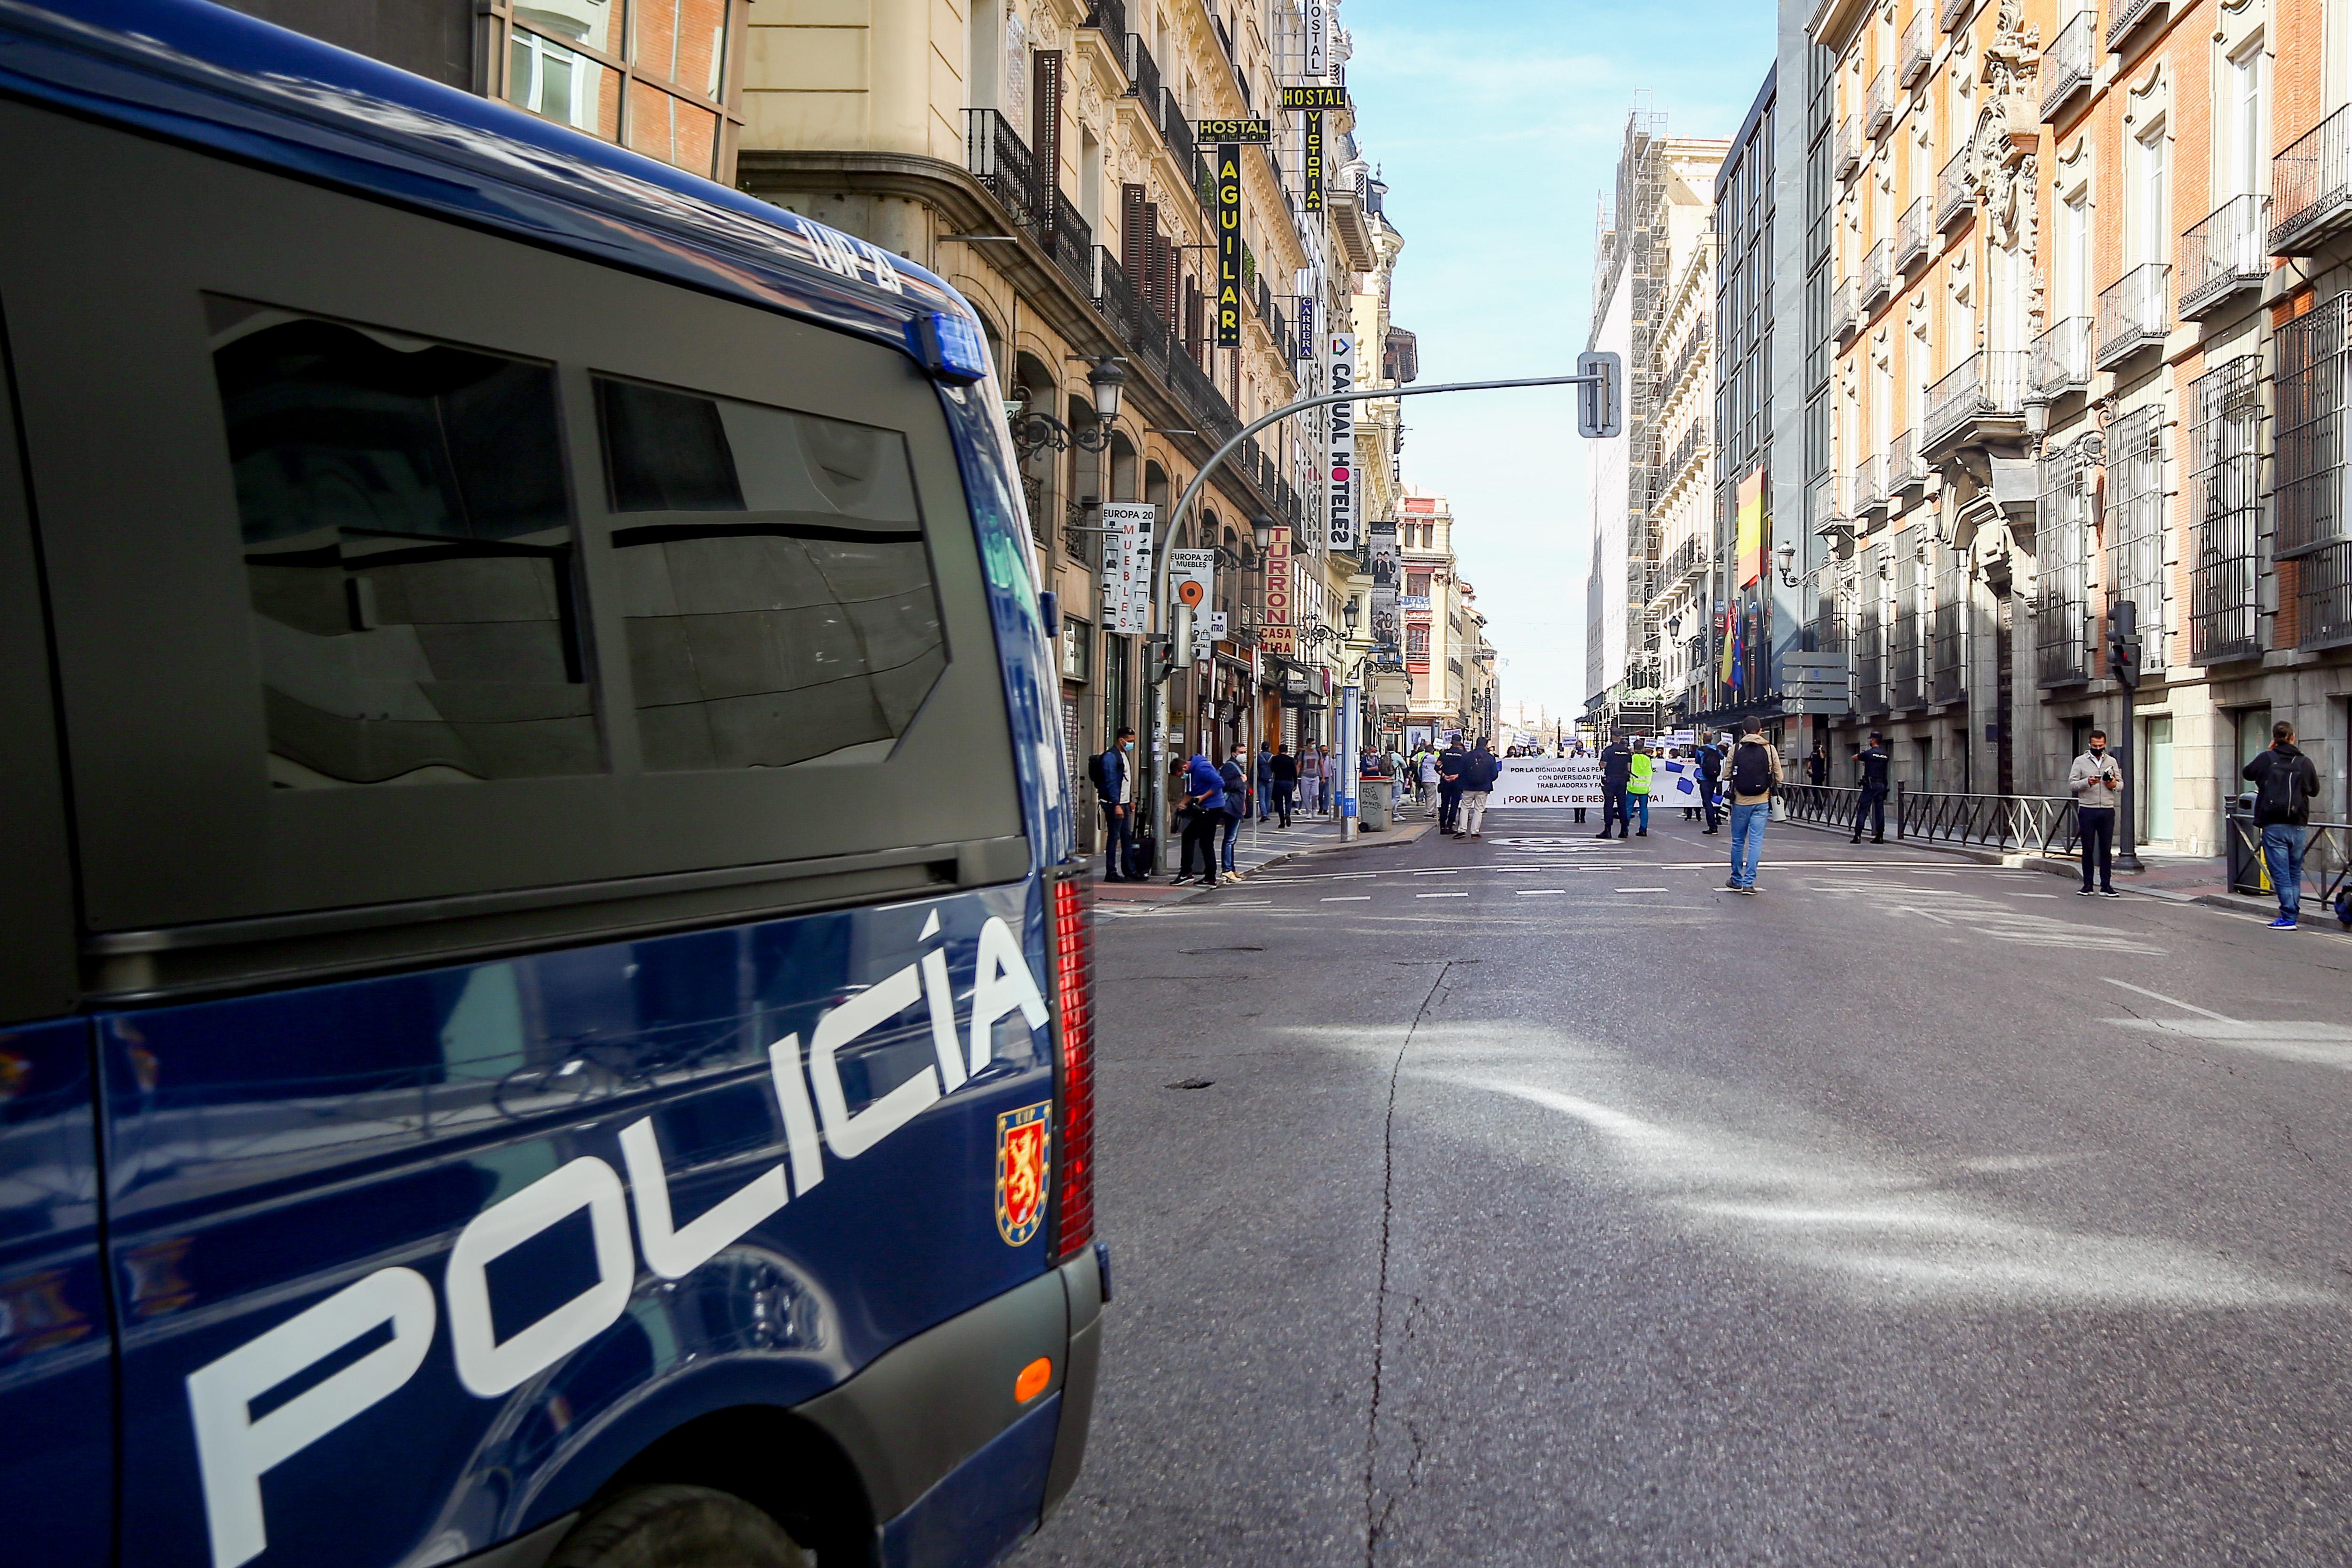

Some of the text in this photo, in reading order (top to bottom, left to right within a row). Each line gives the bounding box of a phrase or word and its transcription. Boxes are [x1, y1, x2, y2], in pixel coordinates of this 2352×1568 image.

[1200, 121, 1268, 134] HOSTAL
[1283, 89, 1345, 106] HOSTAL
[1307, 111, 1321, 201] VICTORIA
[1220, 160, 1238, 329] AGUILAR
[1302, 298, 1311, 357] CARRERA
[1331, 364, 1351, 543] CAUAL HOTELES
[1104, 509, 1153, 519] EUROPA 20
[1120, 525, 1134, 627] MUEBLES
[1267, 528, 1289, 623] TURRON
[1261, 628, 1291, 638] CASA
[1261, 643, 1290, 653] MIRA
[186, 907, 1050, 1568] POLICÍA
